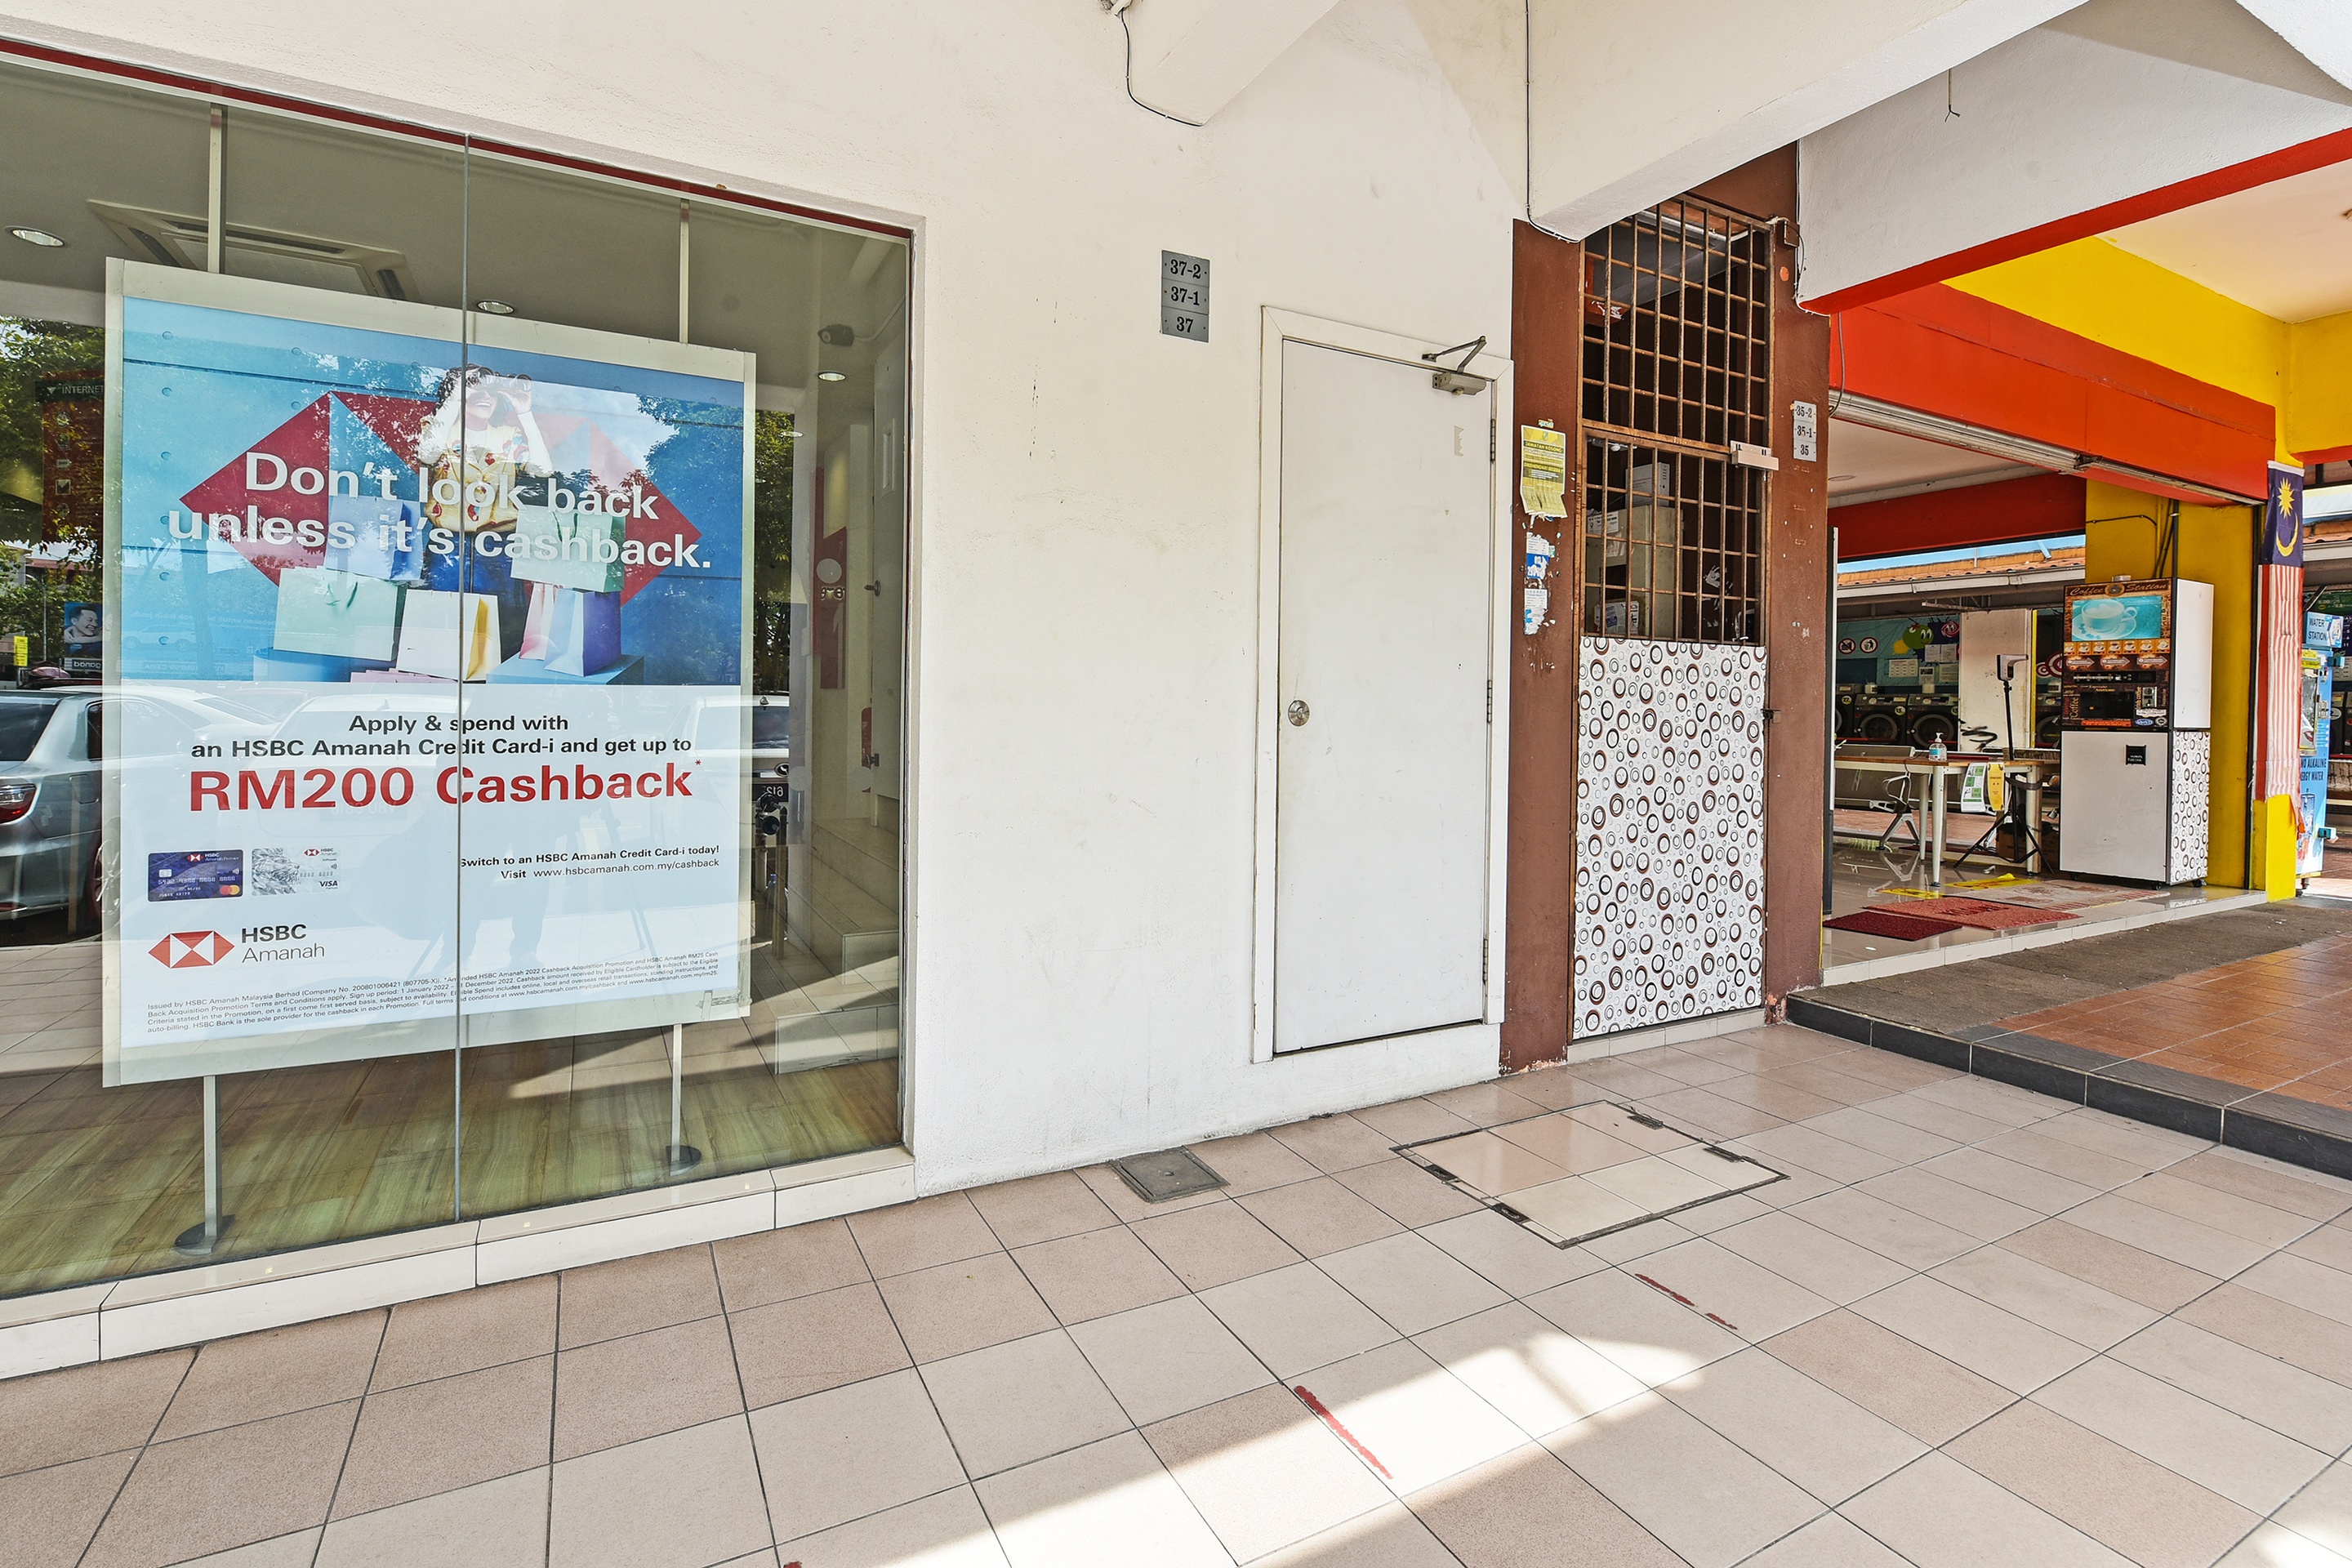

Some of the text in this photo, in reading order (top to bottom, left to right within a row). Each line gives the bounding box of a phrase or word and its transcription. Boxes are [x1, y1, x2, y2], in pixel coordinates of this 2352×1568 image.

[1170, 259, 1201, 279] 37-2
[1171, 286, 1200, 306] 37-1
[1176, 316, 1194, 333] 37
[62, 385, 105, 394] INTERNET
[1797, 405, 1812, 418] 35-2
[1797, 425, 1812, 438] 35-1
[1800, 444, 1809, 456] 35
[246, 451, 659, 520] Don't look back
[169, 505, 710, 569] unless it's cashback.
[2070, 582, 2167, 596] Coffee Station
[2309, 618, 2324, 628] WATER
[2308, 631, 2327, 641] STATION
[2069, 697, 2079, 718] Coffee
[349, 715, 568, 735] Apply & spend with
[191, 737, 691, 757] an HSBC Amanah Credit Card-i and get up to
[2307, 758, 2326, 768] ALKALINE
[2311, 771, 2324, 780] WATER
[190, 766, 414, 811] RM200
[461, 858, 499, 868] Switch
[536, 853, 568, 863] HSBC
[571, 851, 617, 861] Amanah
[620, 848, 651, 859] Credit
[655, 847, 685, 857] Card-i
[688, 845, 719, 856] today!
[501, 858, 719, 879] Visit www.hsbcamanah.com.my/cashback
[242, 924, 306, 943] HSBC
[242, 943, 325, 963] Amanah
[352, 982, 400, 991] 200801006421
[168, 1007, 209, 1016] Acquisition
[376, 989, 399, 997] period:
[147, 1025, 190, 1033] auto-billing.
[273, 1014, 301, 1022] provider
[327, 1008, 358, 1016] cashback
